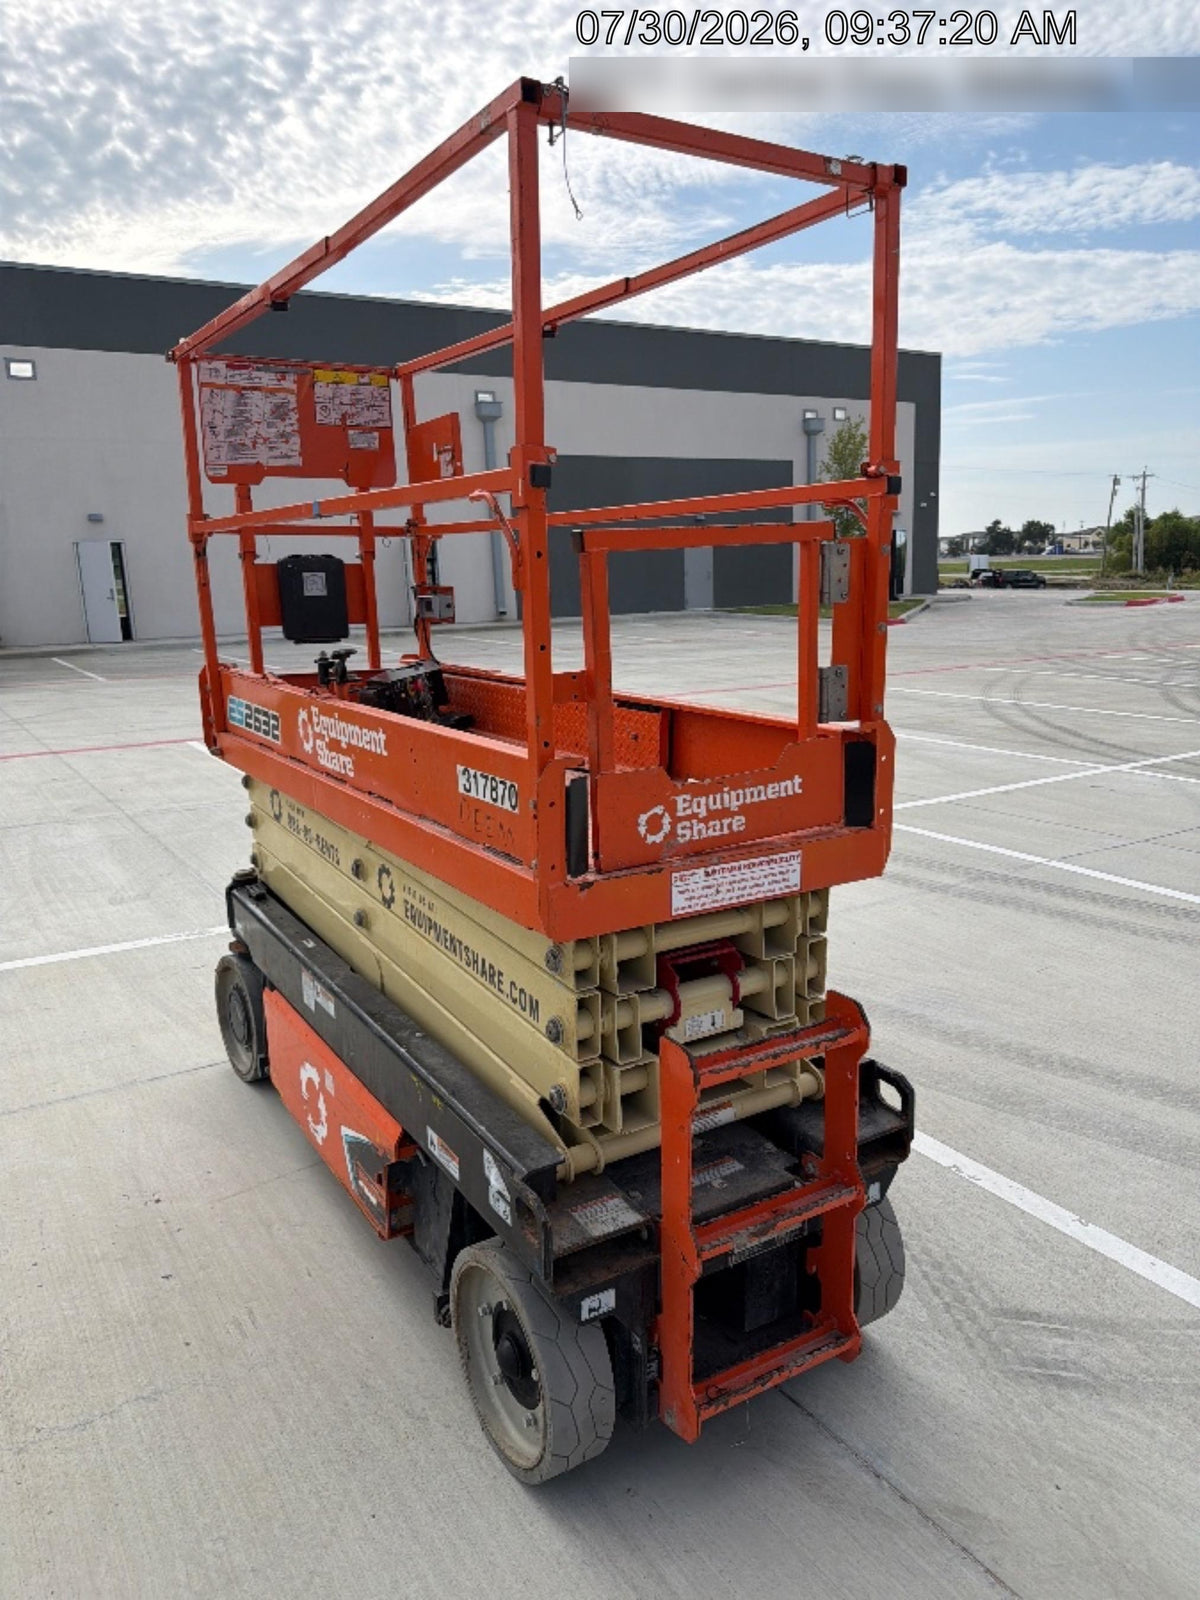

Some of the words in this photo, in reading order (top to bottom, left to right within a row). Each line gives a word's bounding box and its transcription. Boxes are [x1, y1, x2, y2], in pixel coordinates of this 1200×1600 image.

[310, 705, 388, 757] Equipment
[316, 738, 355, 777] Share
[461, 767, 518, 811] 317870
[675, 774, 803, 816] Equipment
[676, 814, 746, 843] Share
[403, 899, 540, 1024] EQUIPMENTSHARE.COM
